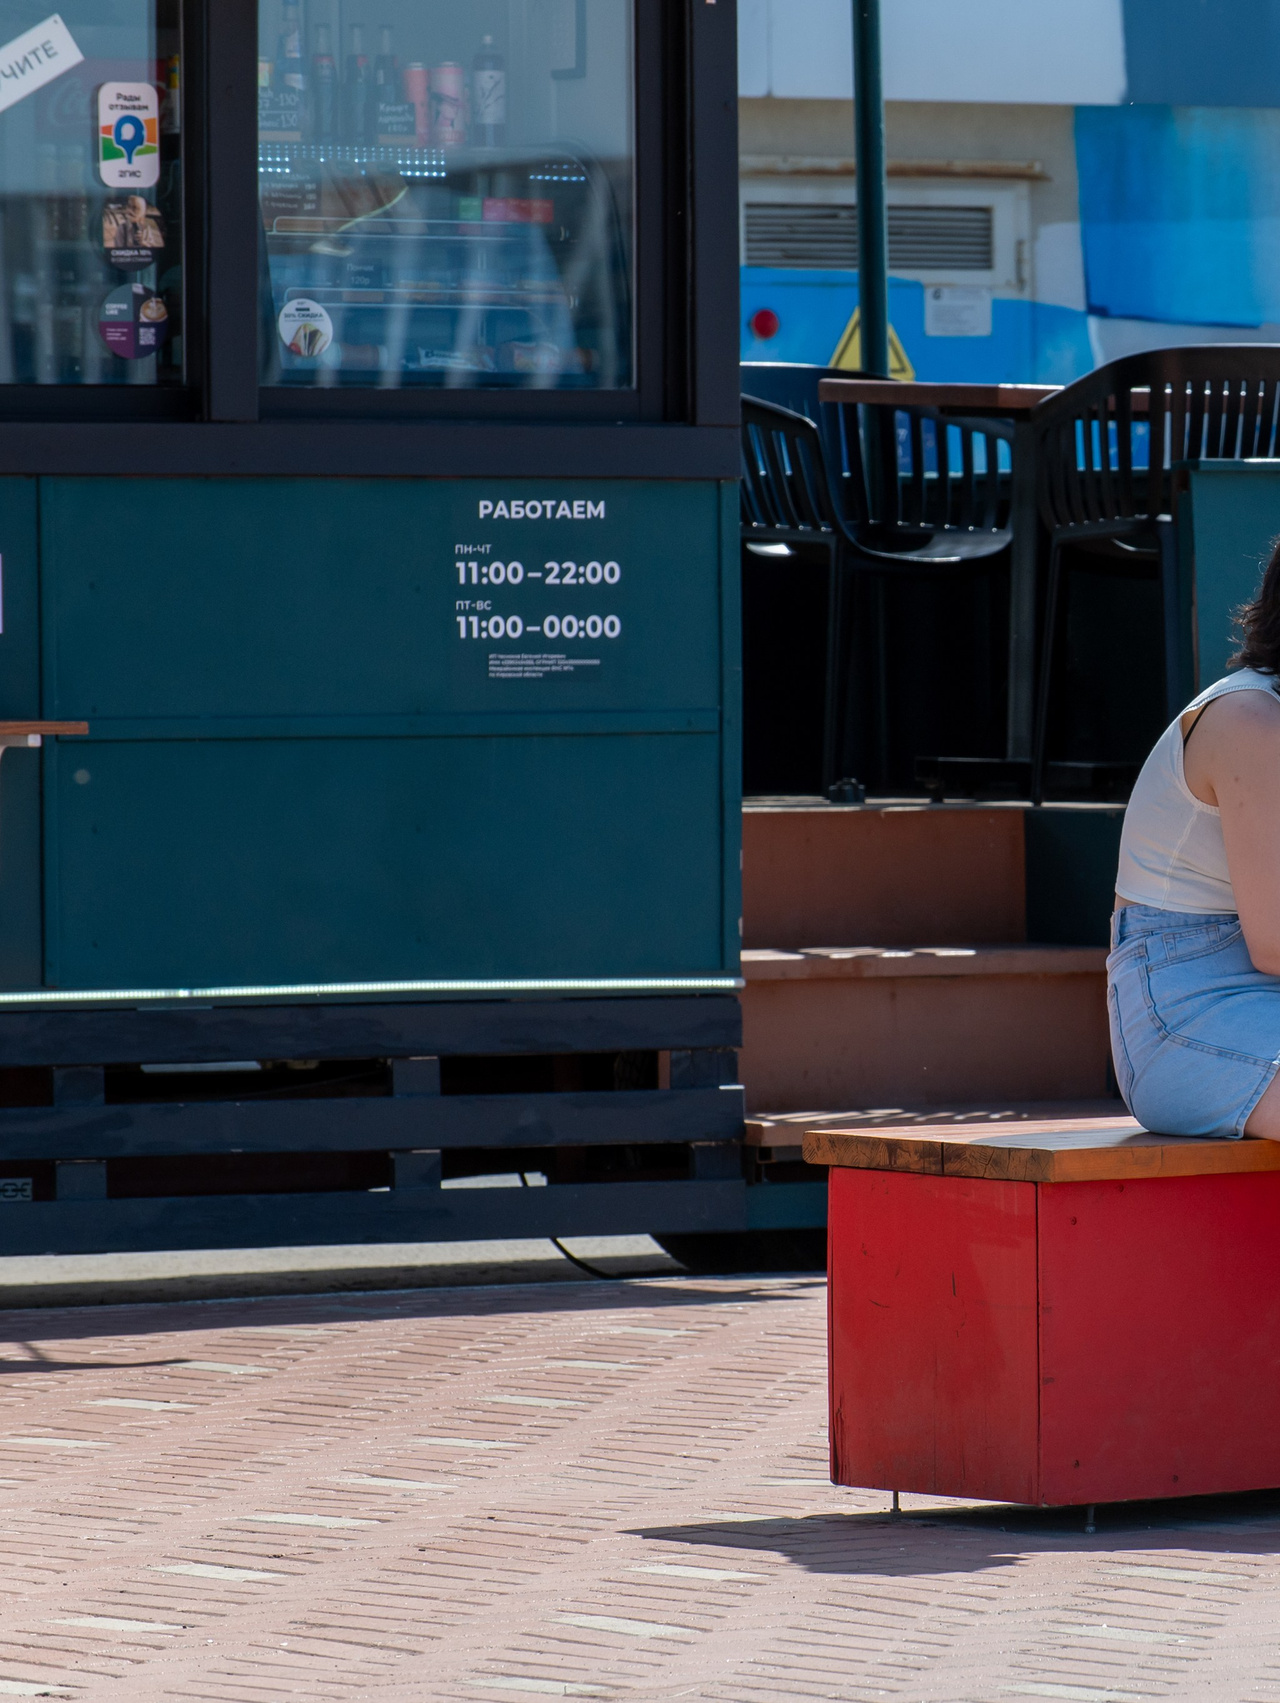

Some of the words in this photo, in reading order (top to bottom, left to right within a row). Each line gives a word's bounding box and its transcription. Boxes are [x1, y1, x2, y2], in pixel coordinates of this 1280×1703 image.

[0, 39, 59, 80] ЧИТЕ
[116, 92, 141, 102] Рады
[108, 103, 150, 112] отзывам
[118, 170, 142, 179] 2ГИС
[478, 500, 606, 519] РАБОТАЕМ
[455, 544, 492, 555] ПН-ЧТ
[455, 600, 492, 611] ПТ-ВС
